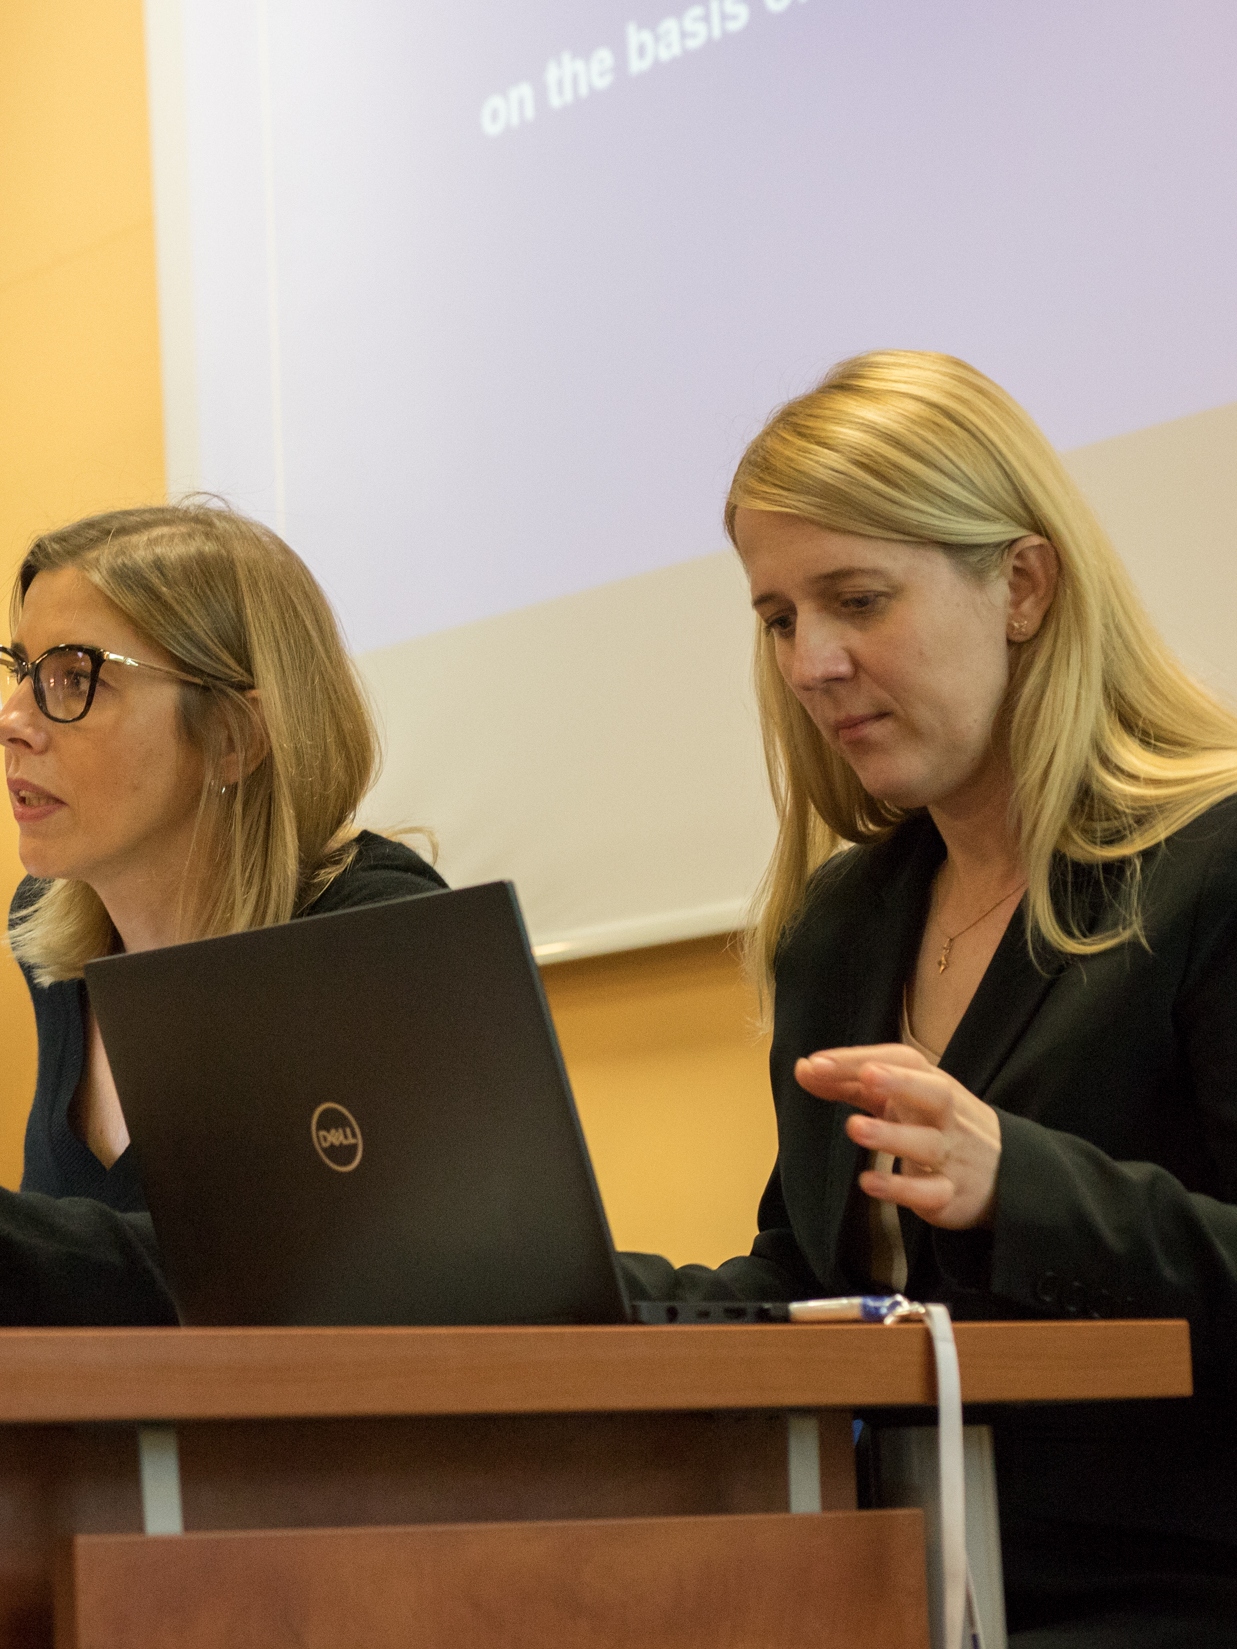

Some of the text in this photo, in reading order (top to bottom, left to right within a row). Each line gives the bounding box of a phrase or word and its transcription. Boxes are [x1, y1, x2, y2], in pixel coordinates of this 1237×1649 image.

[480, 0, 751, 137] on the basis
[318, 1126, 359, 1149] DELL
